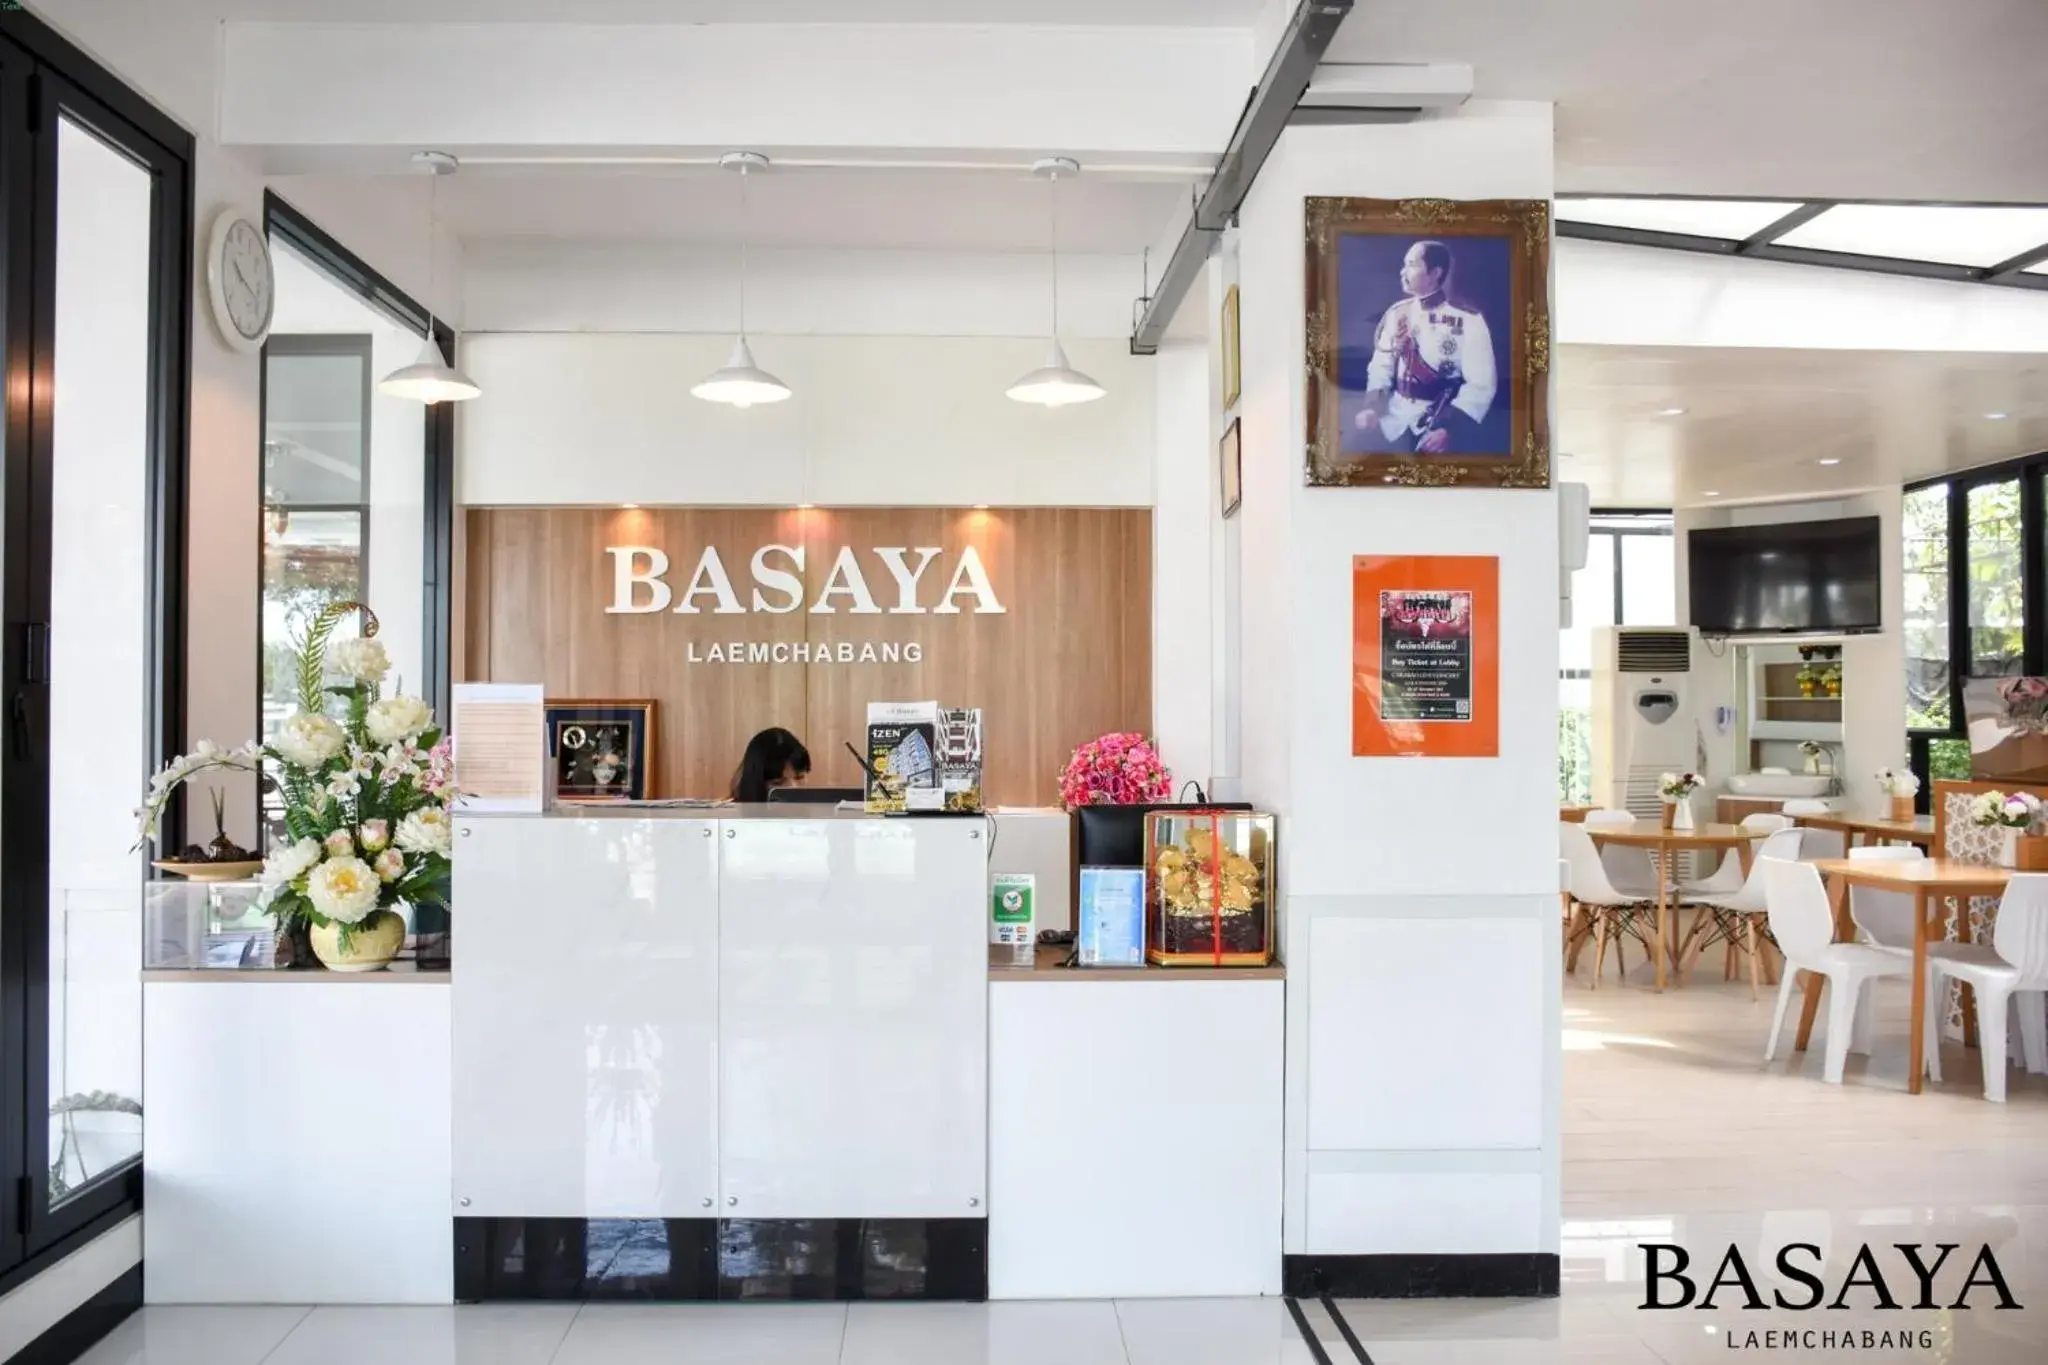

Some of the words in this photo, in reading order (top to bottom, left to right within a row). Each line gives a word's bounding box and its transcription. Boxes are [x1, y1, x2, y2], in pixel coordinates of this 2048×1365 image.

[605, 544, 1006, 614] BASAYA
[687, 641, 923, 664] LAEMCHABANG
[1408, 658, 1428, 666] Ticket
